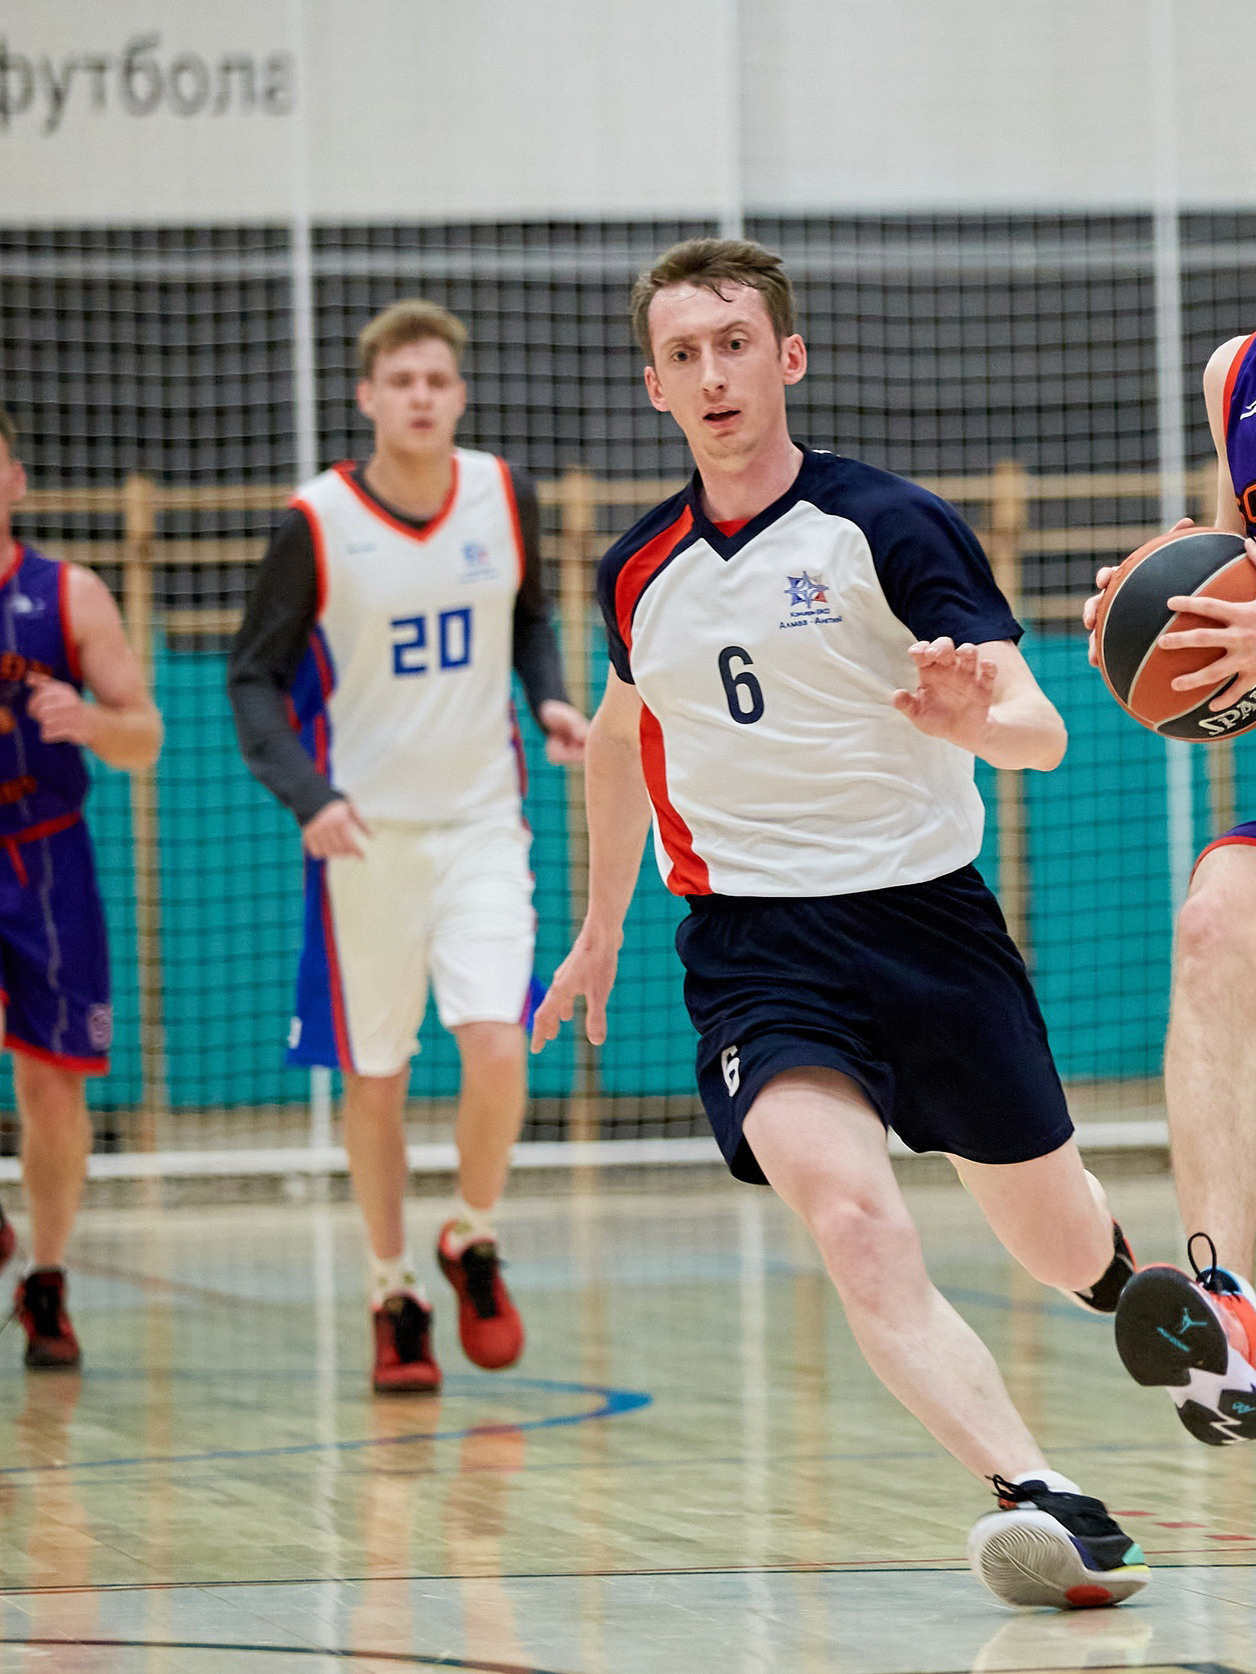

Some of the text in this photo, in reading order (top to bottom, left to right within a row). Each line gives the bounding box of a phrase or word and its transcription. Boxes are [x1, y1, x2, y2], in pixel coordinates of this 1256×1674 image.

[390, 606, 472, 676] 20
[718, 646, 764, 724] 6
[721, 1045, 738, 1097] 6
